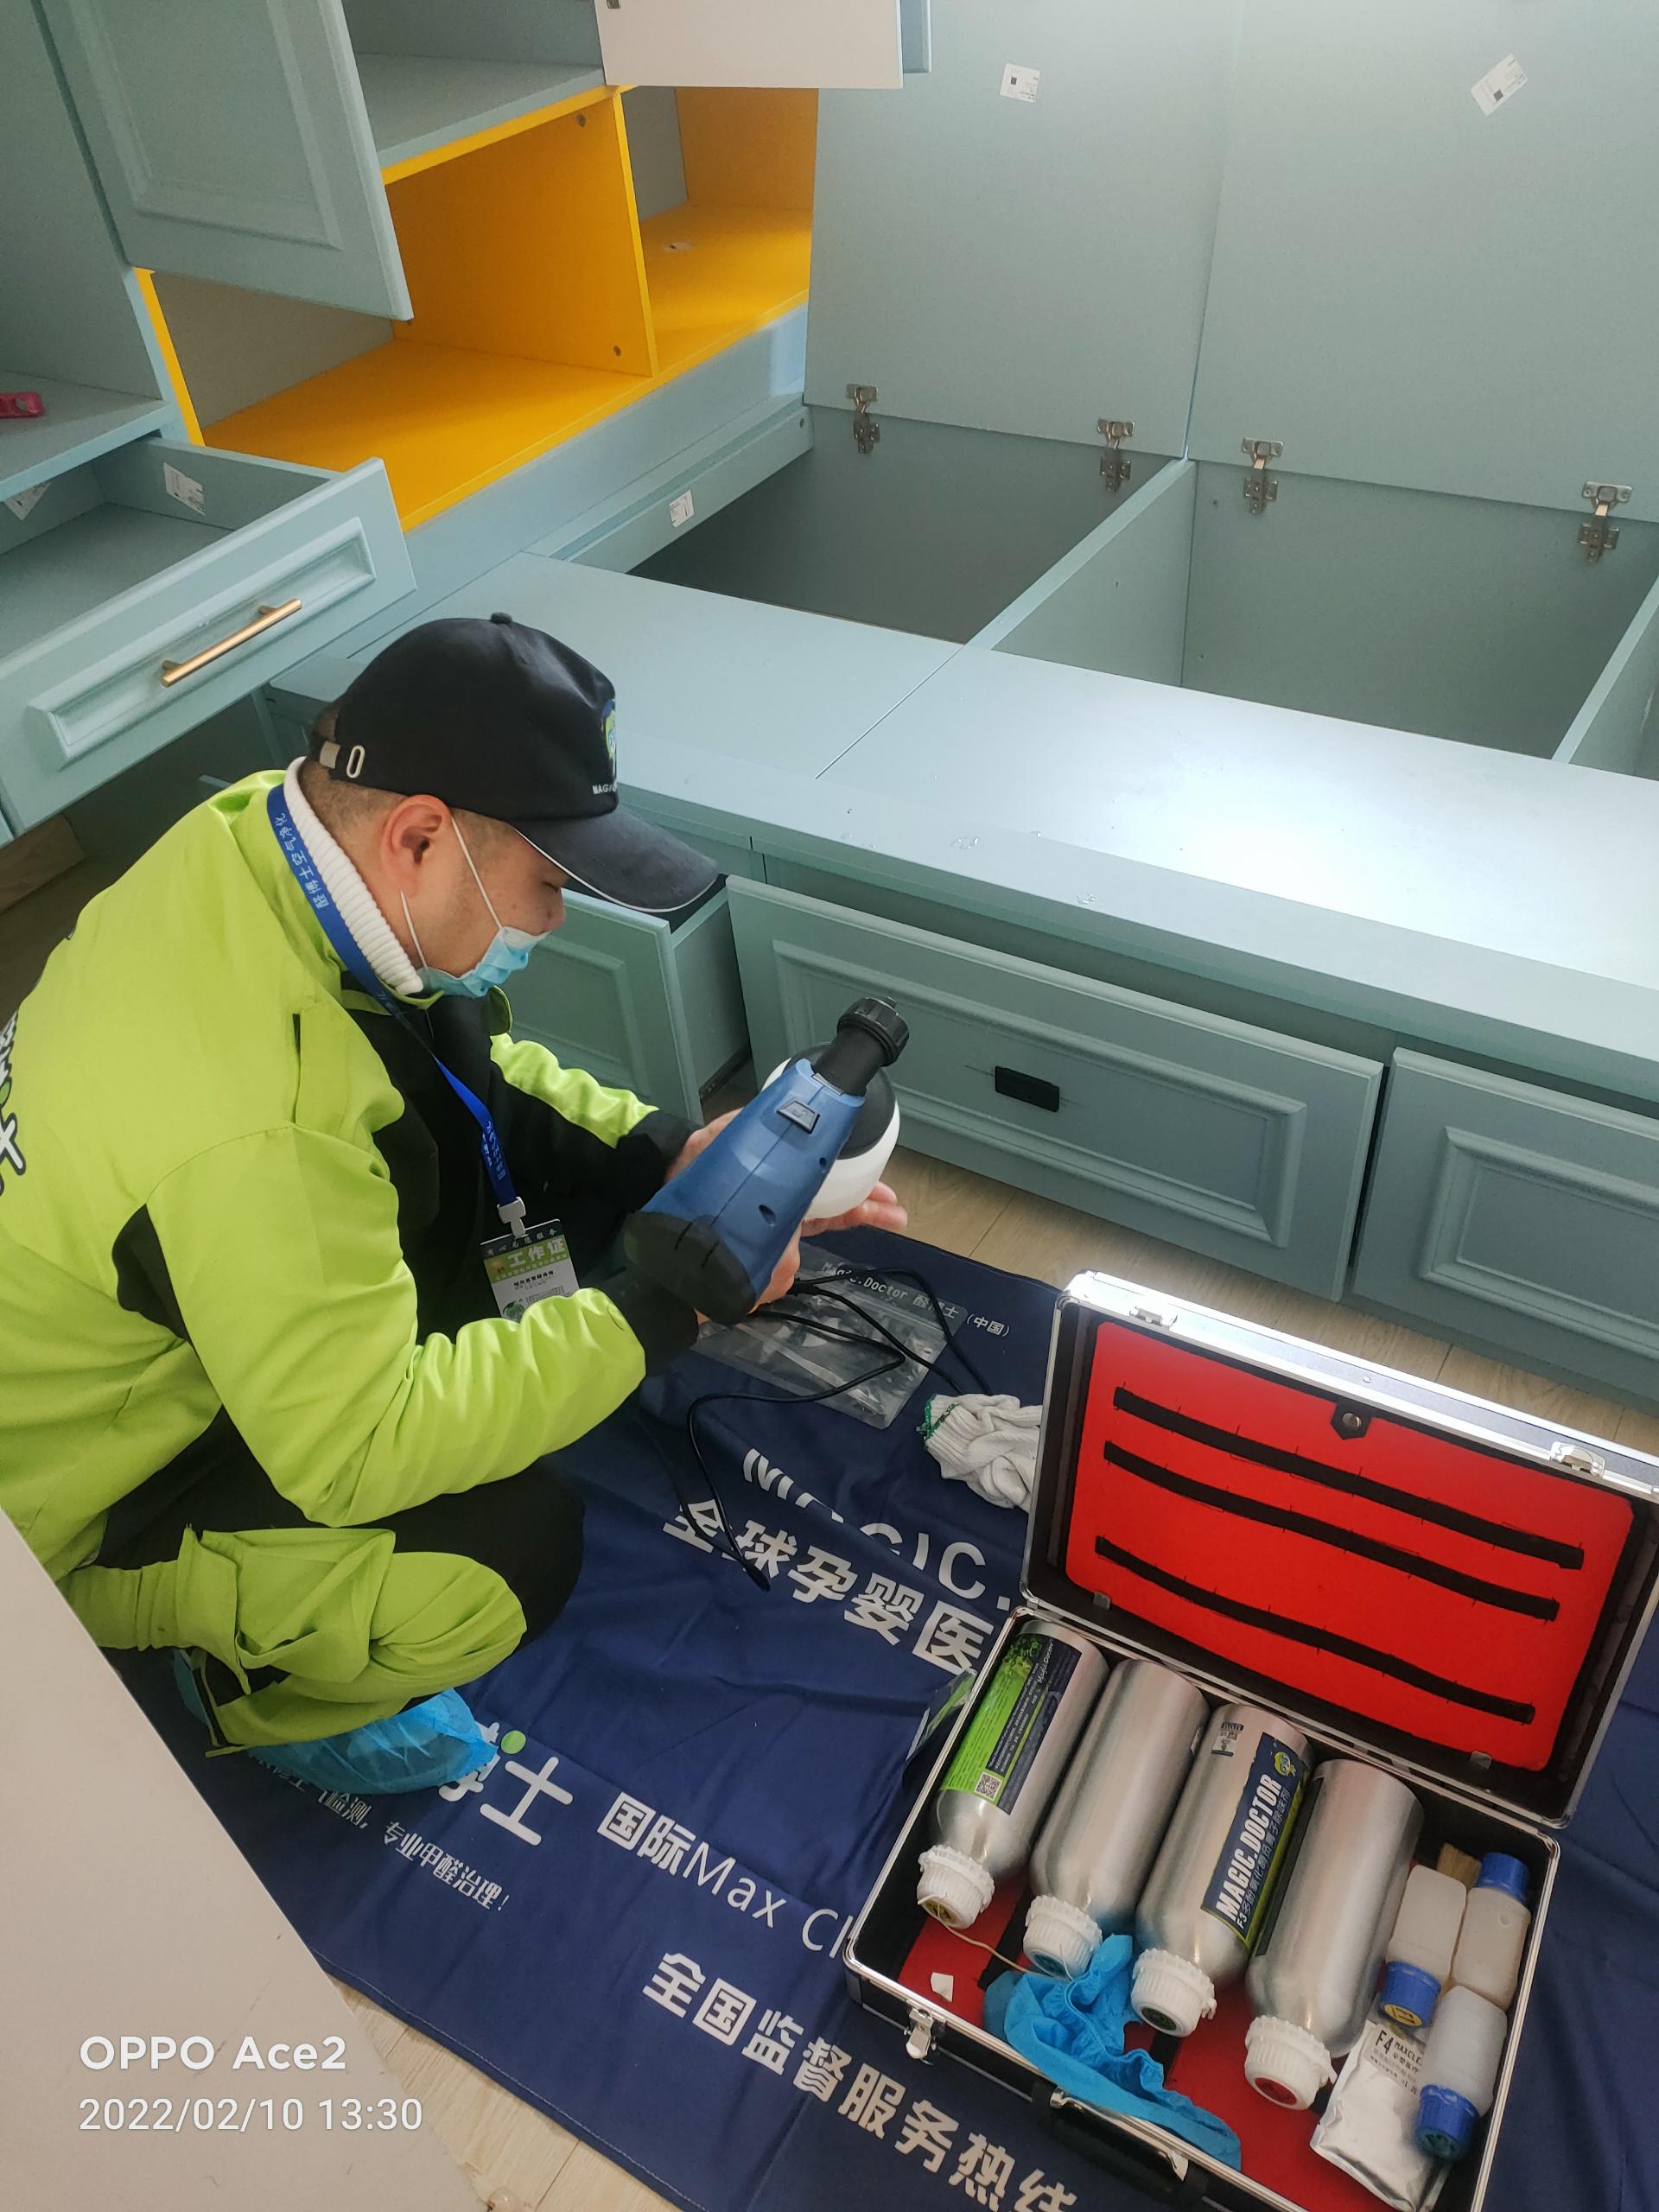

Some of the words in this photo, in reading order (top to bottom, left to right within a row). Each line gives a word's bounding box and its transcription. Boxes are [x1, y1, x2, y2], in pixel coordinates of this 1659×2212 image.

[275, 812, 329, 909] 醛博士空气净化
[507, 1238, 566, 1268] 工作证
[743, 1448, 1011, 1611] MIC.
[1216, 1773, 1282, 1923] MAGIC.DOCTOR
[642, 1952, 1078, 2212] 全国监督服务热线
[1375, 2030, 1395, 2056] F4
[1394, 2042, 1424, 2066] MAXCLE
